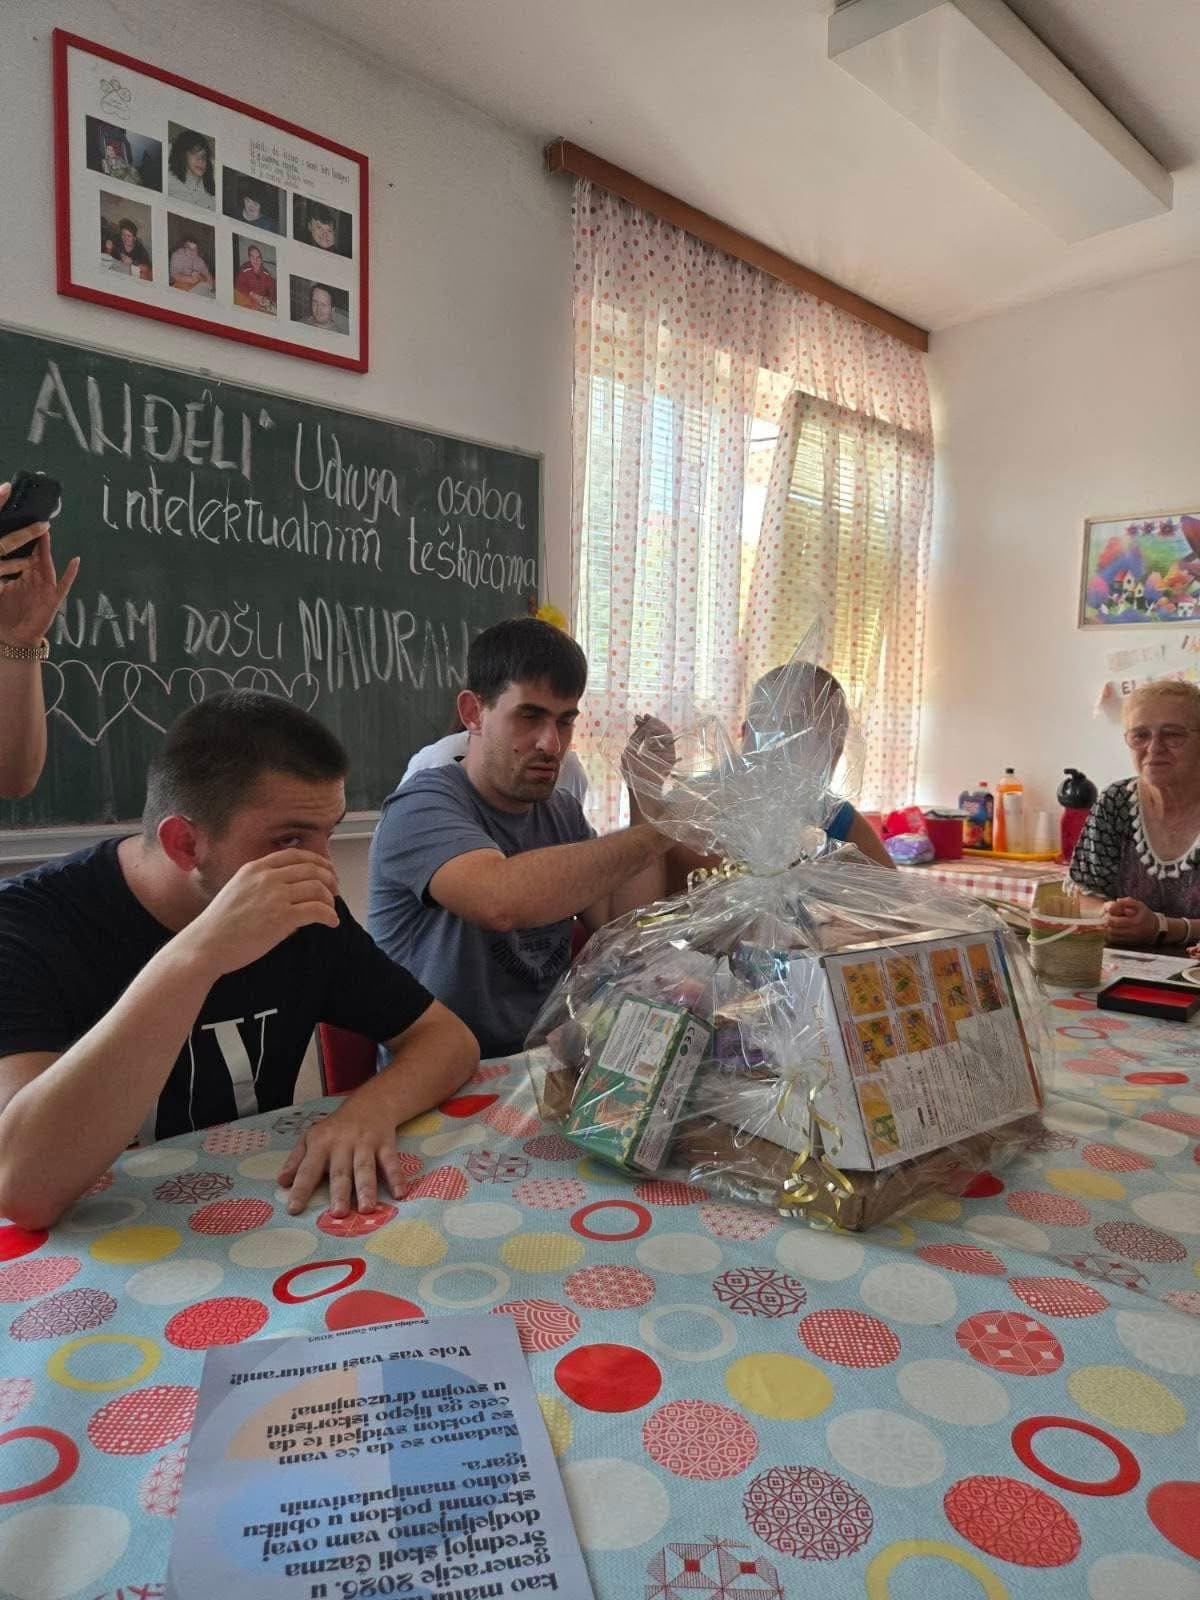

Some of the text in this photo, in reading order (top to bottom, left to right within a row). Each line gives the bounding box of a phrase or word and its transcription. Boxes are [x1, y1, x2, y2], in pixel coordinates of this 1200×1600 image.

[295, 422, 400, 524] Udruga
[437, 475, 526, 530] osoba
[407, 516, 540, 596] teškoćama
[53, 592, 158, 664] NAM
[298, 597, 483, 694] MATURAN
[389, 1349, 424, 1360] vas
[428, 1345, 473, 1358] Vole
[229, 1361, 338, 1386] maturanti!
[421, 1383, 489, 1400] svojim
[493, 1381, 507, 1391] u
[375, 1403, 432, 1421] lijepo
[437, 1398, 463, 1413] ga
[266, 1413, 369, 1438] iskoristiti
[268, 1409, 514, 1452] se poklon svidjeti te da
[430, 1424, 520, 1444] Nadamo
[366, 1441, 394, 1455] da
[400, 1437, 425, 1448] se
[279, 1451, 328, 1465] vam
[461, 1452, 527, 1470] igara.
[280, 1470, 531, 1516] stolno manipulativnih
[243, 1488, 537, 1538] skromni poklon u obliku
[262, 1508, 541, 1562] dodjeljujemo vam ovaj
[284, 1553, 372, 1577] Čazma
[378, 1543, 438, 1571] školi
[421, 1547, 551, 1587] generacije
[310, 1583, 328, 1599] u
[510, 1572, 558, 1592] kao
